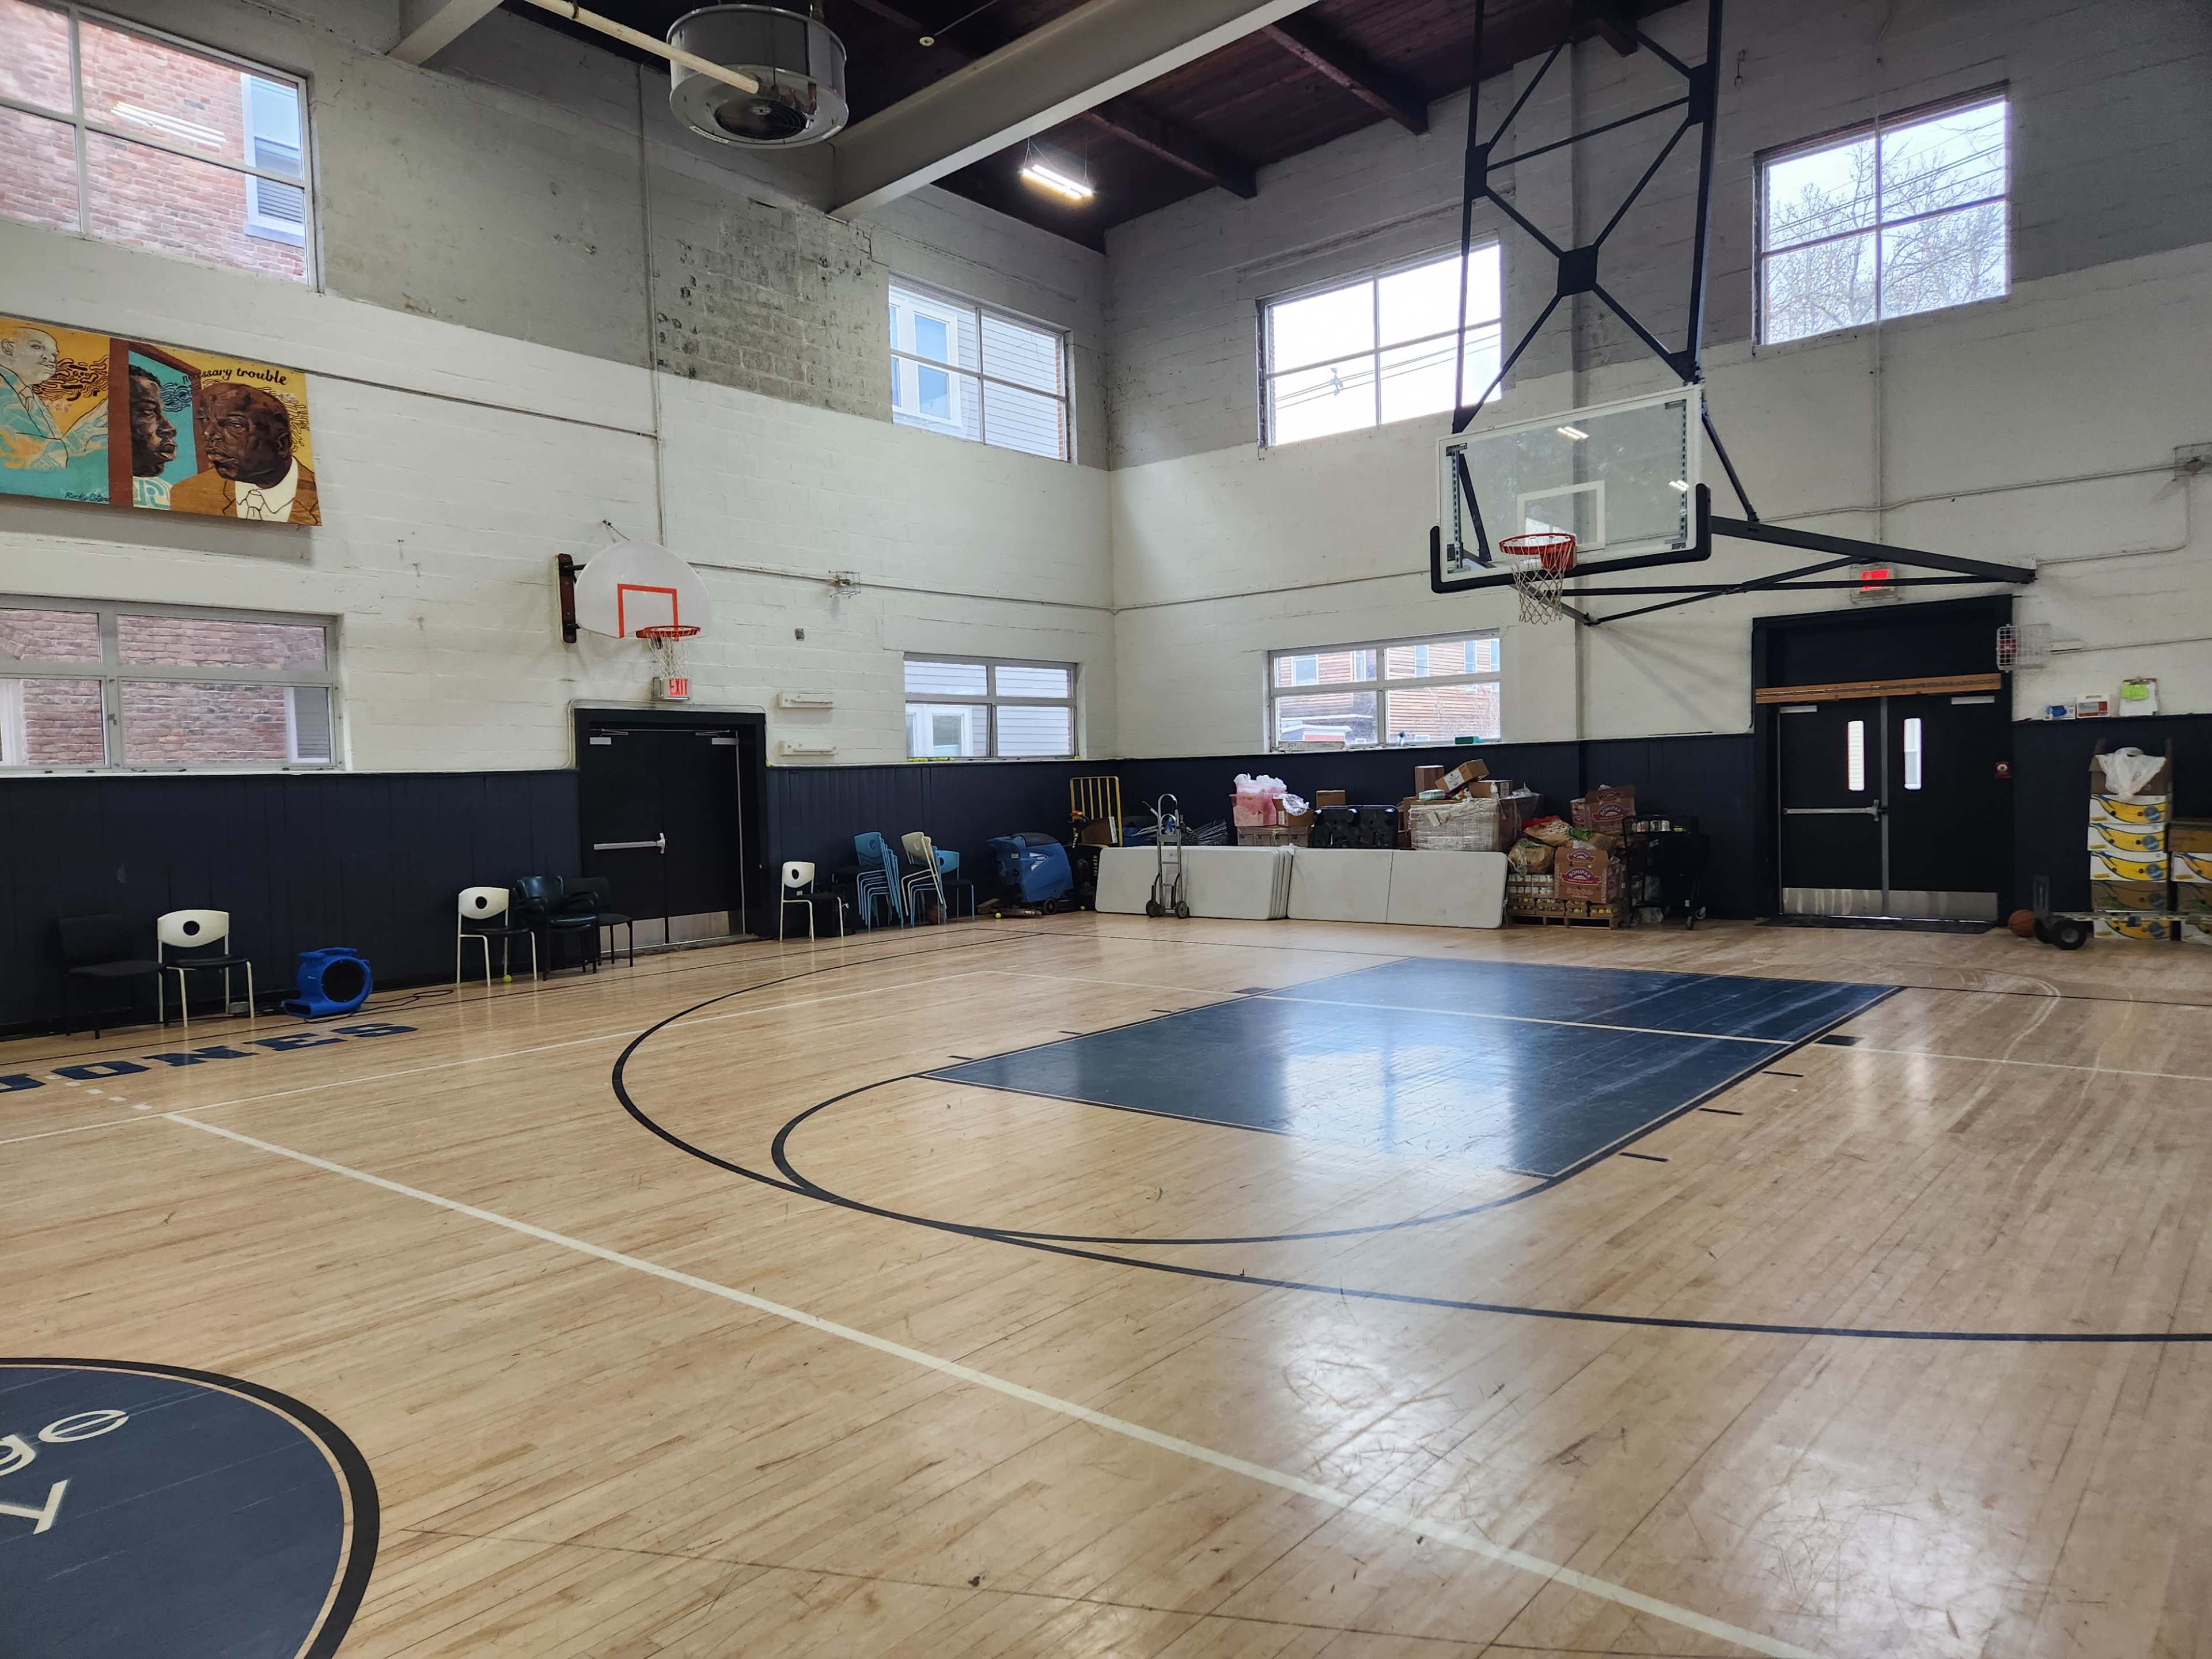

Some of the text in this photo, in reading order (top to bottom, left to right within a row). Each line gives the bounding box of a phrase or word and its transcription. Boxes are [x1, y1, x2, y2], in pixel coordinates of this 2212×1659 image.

[182, 368, 286, 385] necessary trouble
[669, 678, 688, 695] EXIT
